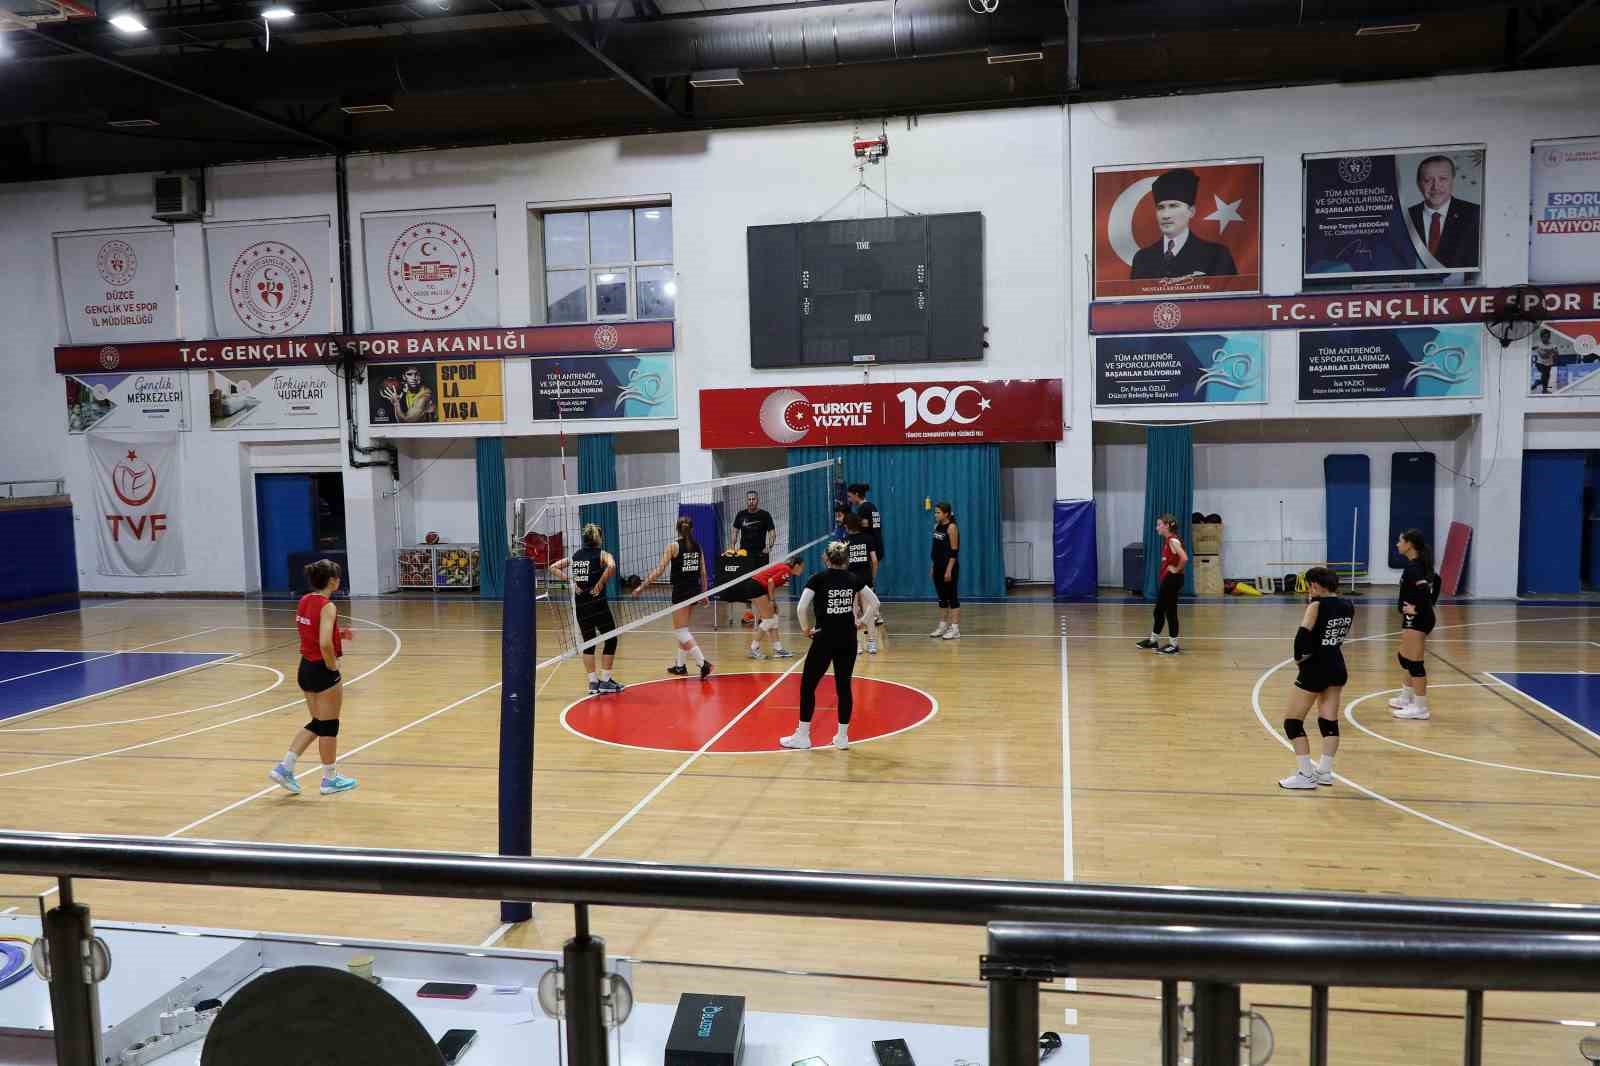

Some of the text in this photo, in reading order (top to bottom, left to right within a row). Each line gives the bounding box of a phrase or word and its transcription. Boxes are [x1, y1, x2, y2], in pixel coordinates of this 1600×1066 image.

[123, 303, 135, 313] VE
[135, 302, 158, 312] SPOR
[1267, 303, 1315, 321] T.C.
[1326, 294, 1449, 319] GENÇLİK
[1459, 296, 1495, 314] VE
[179, 348, 214, 362] T.C.
[221, 341, 308, 361] GENÇLİK
[314, 342, 340, 357] VE
[407, 330, 526, 353] BAKANLIĞI
[1319, 347, 1337, 356] TÜM
[1114, 353, 1131, 361] TÜM
[278, 388, 323, 400] YURTLARI
[443, 382, 459, 398] LA
[442, 402, 479, 420] YAŞA
[105, 513, 167, 541] TVF
[828, 589, 853, 598] SPOR
